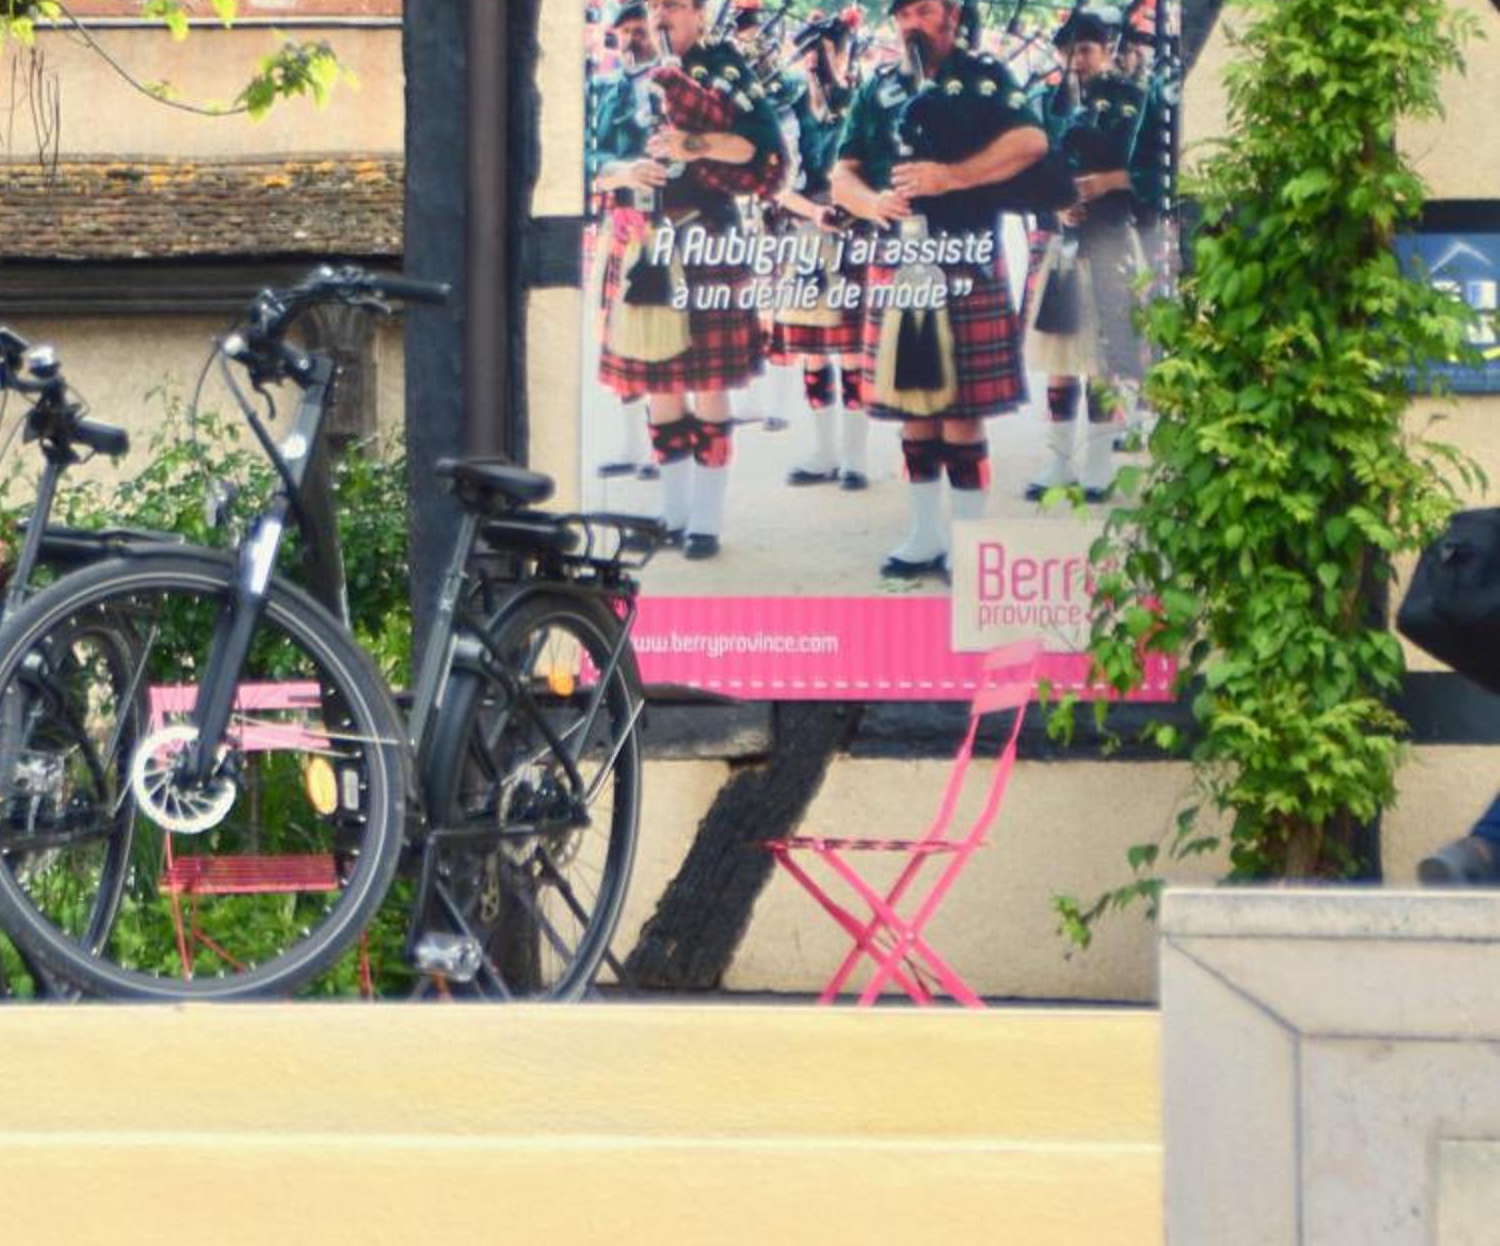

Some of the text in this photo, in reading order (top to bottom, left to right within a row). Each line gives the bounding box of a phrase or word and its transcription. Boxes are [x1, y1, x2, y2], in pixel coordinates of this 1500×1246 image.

[651, 217, 995, 275] À Aubigny, j'ai assisté
[671, 277, 689, 310] à
[696, 283, 732, 310] un
[739, 275, 820, 310] défilé
[827, 276, 862, 310] de
[978, 604, 1082, 631] province
[630, 631, 839, 659] ww.berryprovince.com
